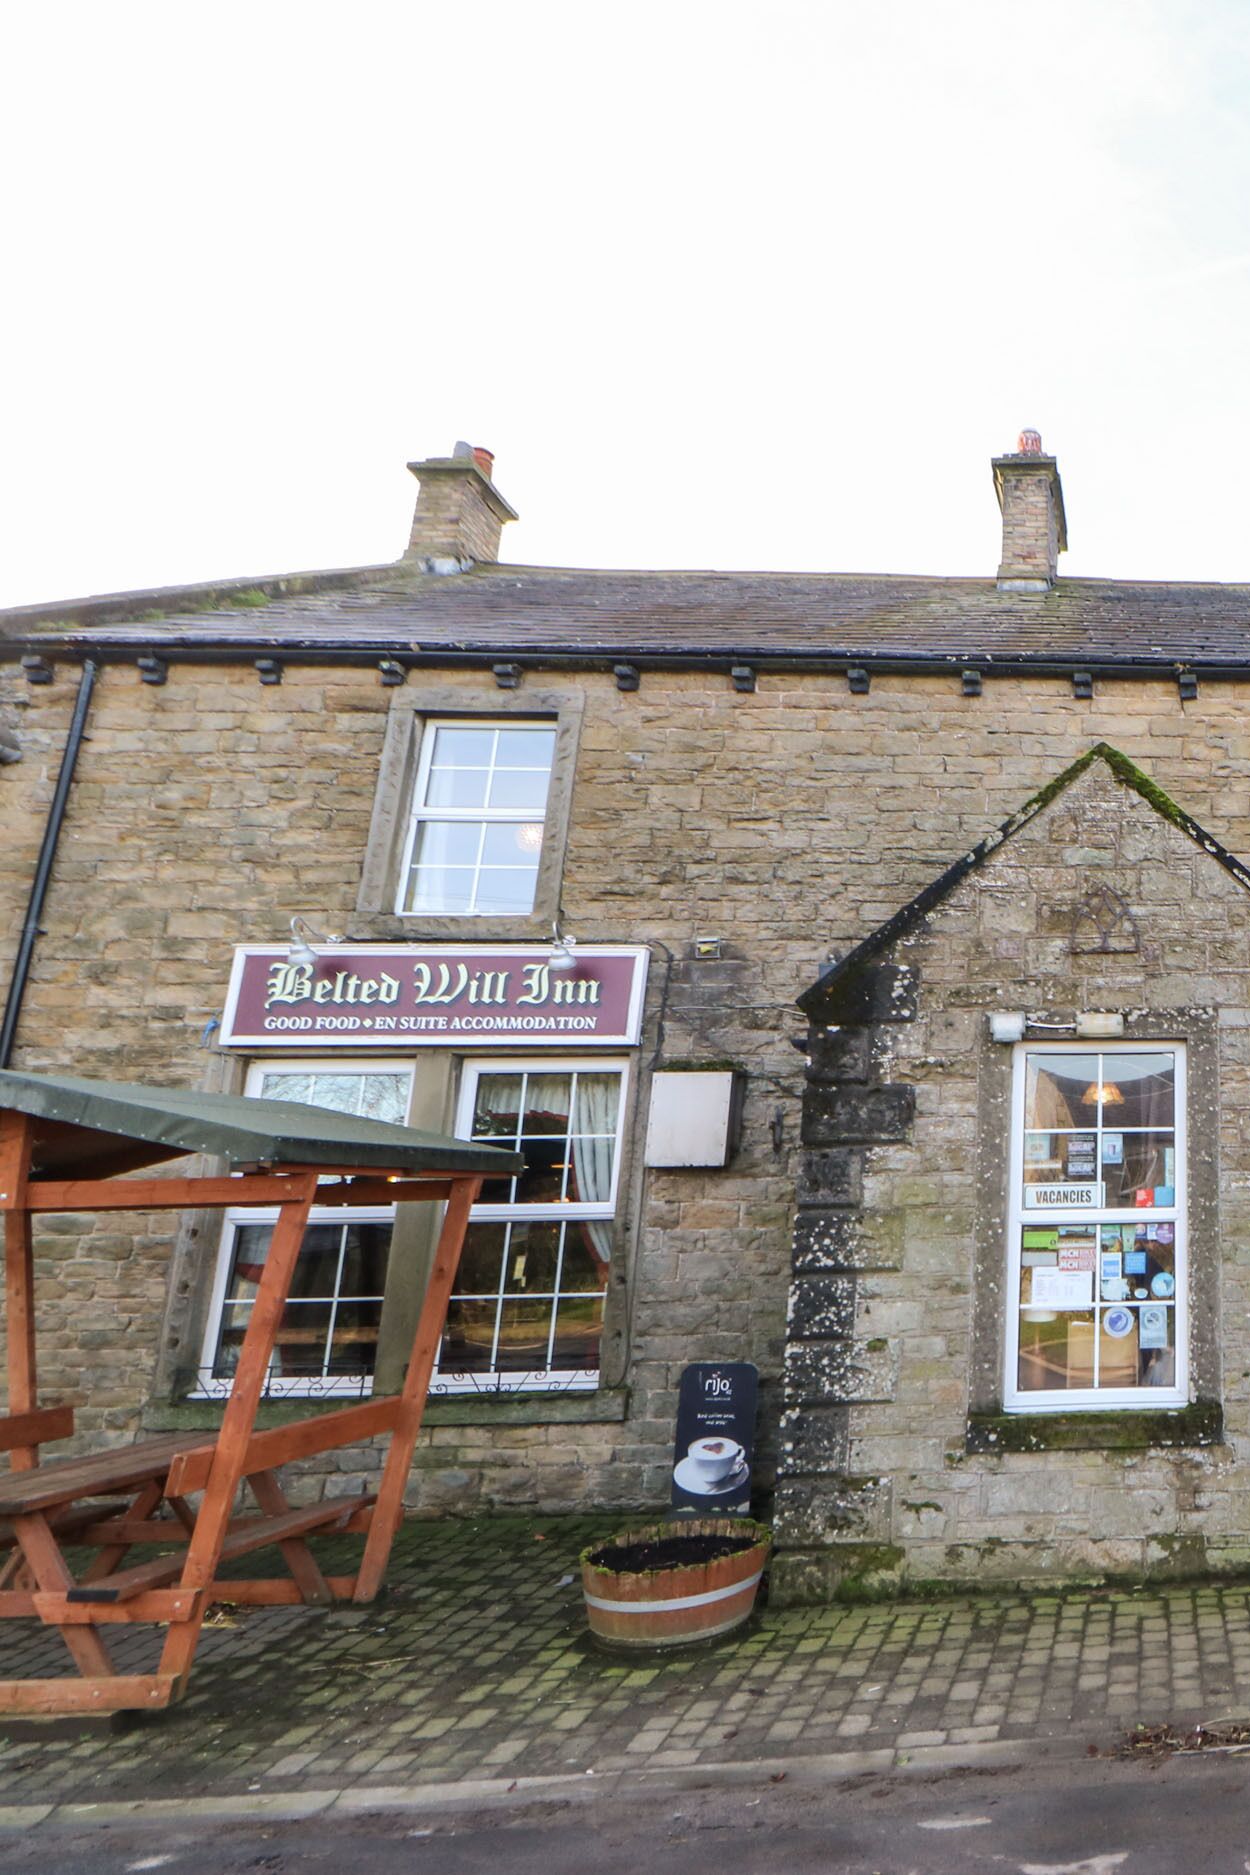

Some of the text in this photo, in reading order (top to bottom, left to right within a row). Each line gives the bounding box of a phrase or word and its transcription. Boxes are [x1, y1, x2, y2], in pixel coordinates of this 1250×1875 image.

[264, 962, 601, 1009] Belted Will Inn
[264, 1016, 598, 1030] GOOD FOOD EN SUITE ACCOMMODATION
[1035, 1189, 1092, 1205] VACANCIES
